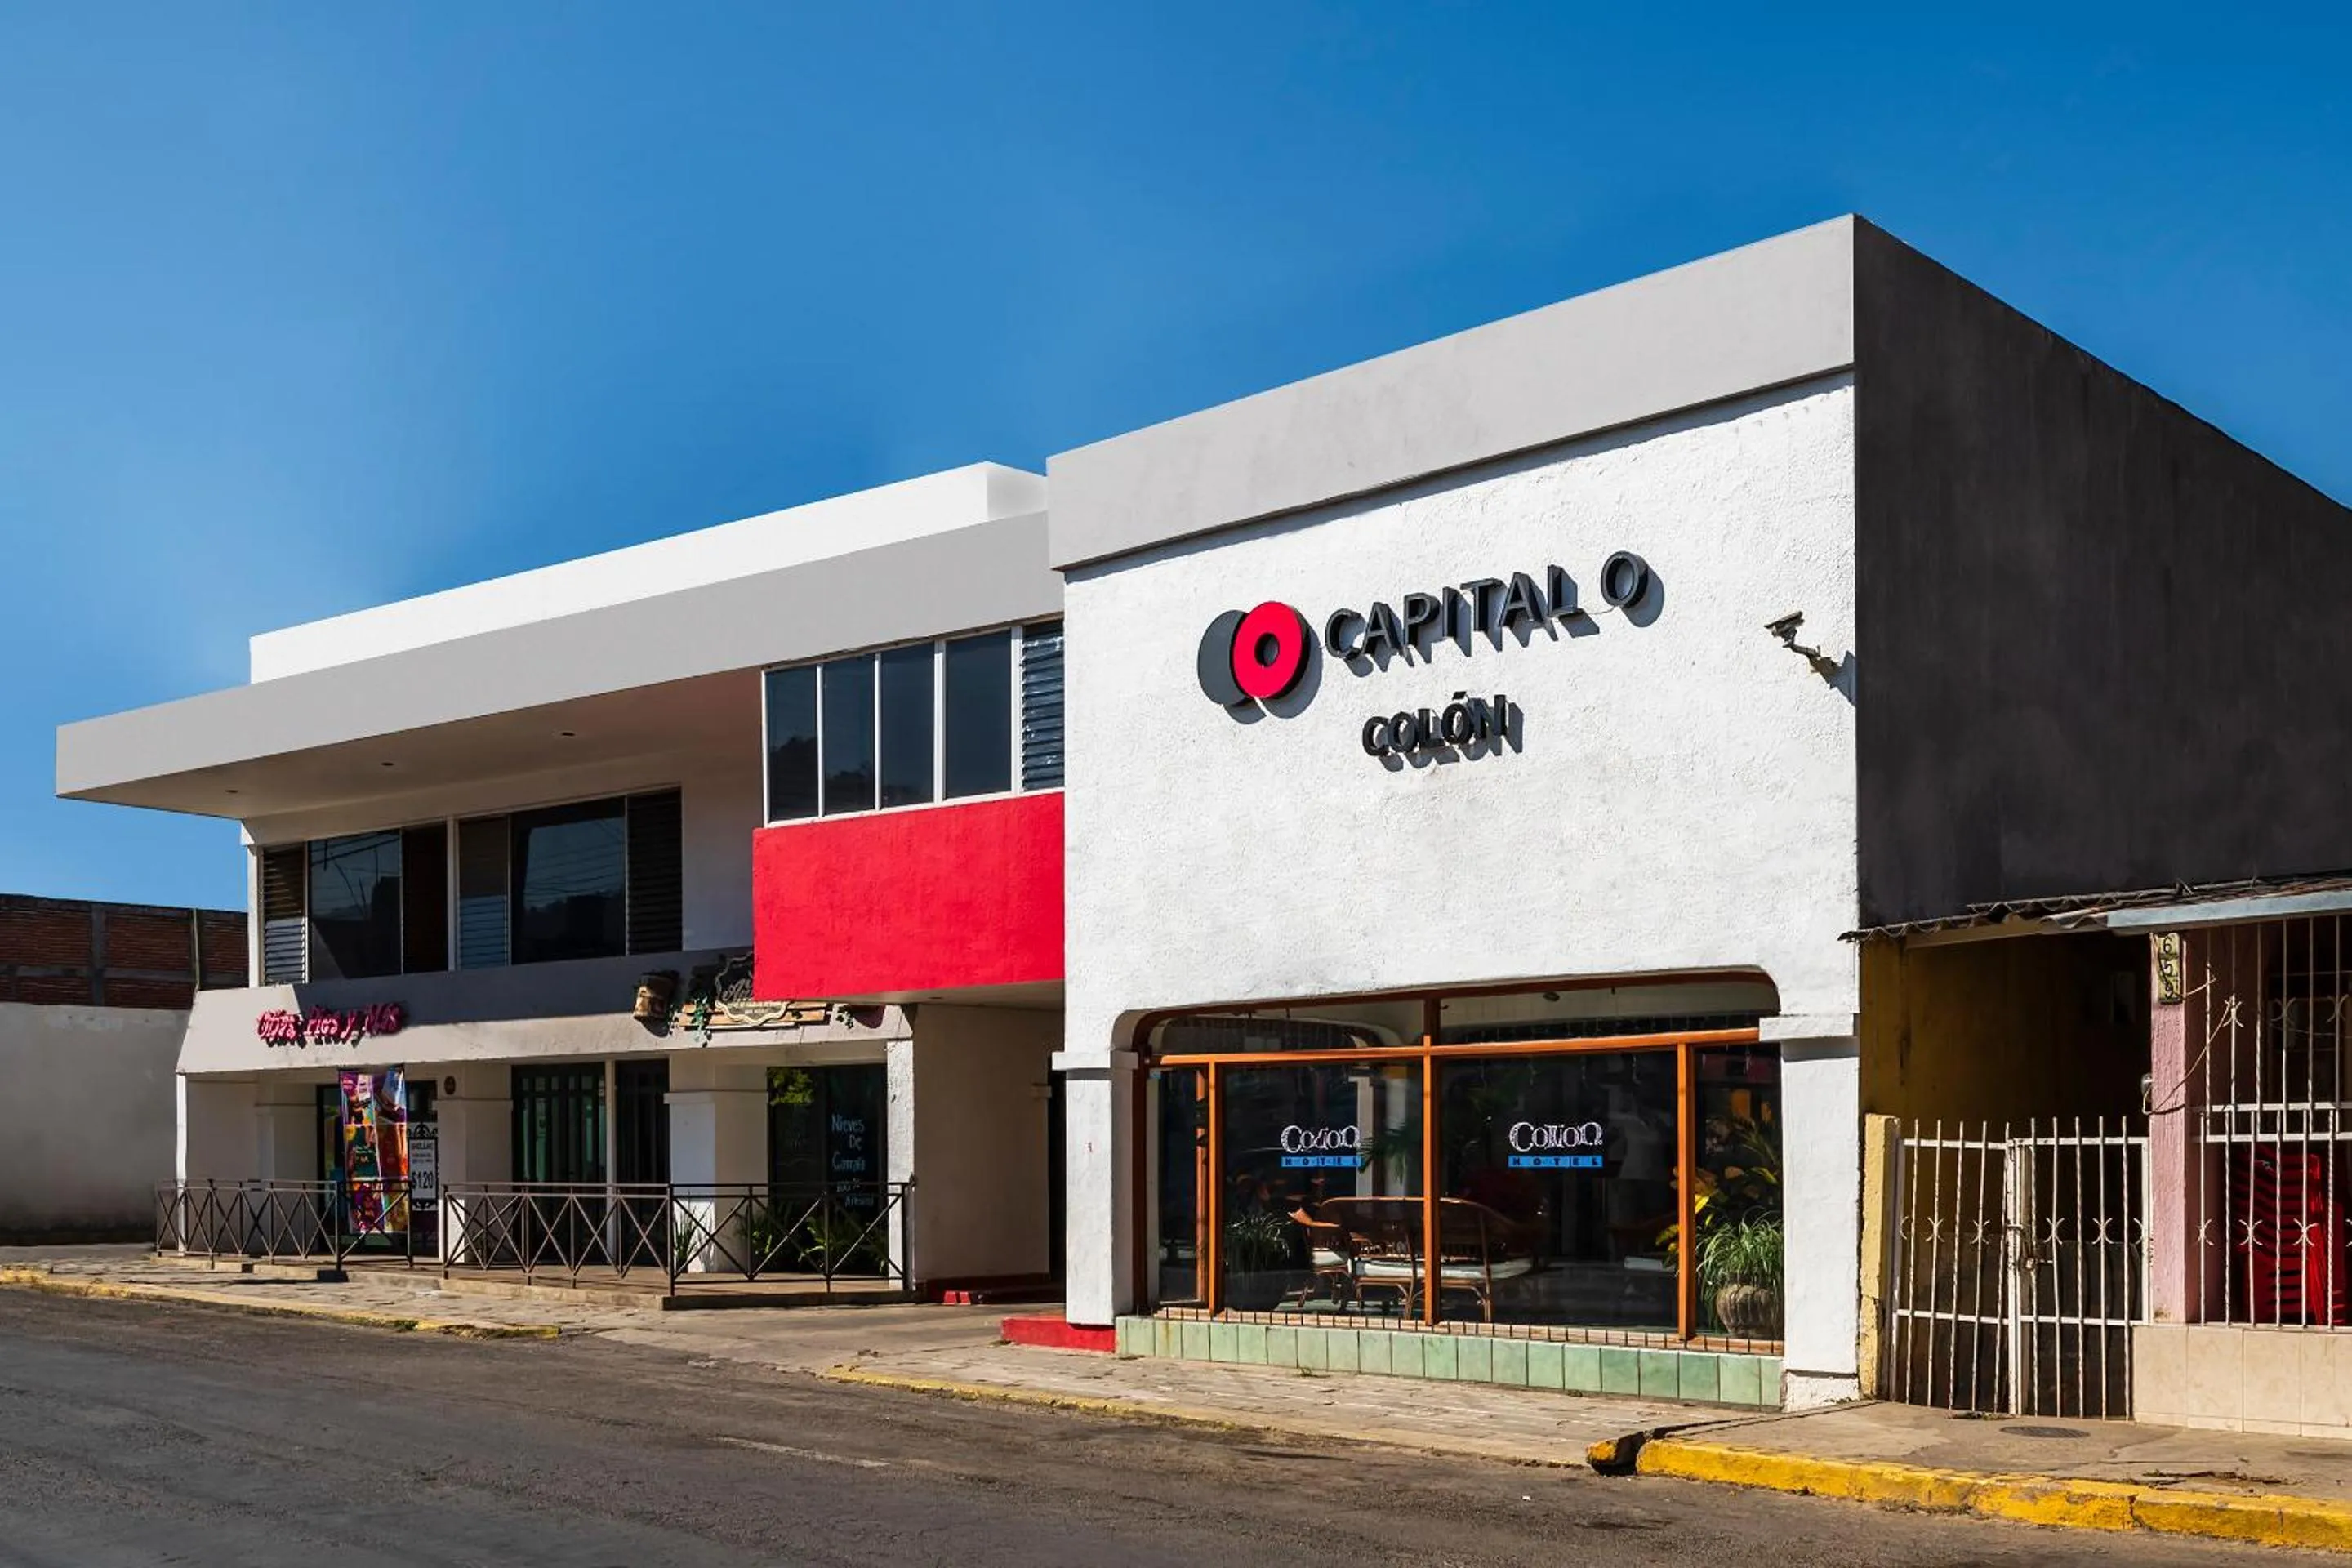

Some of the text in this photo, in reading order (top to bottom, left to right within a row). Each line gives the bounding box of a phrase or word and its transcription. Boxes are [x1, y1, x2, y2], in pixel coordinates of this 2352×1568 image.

[1324, 550, 1649, 660] CAPITAL O
[1362, 691, 1507, 758] COLÓN
